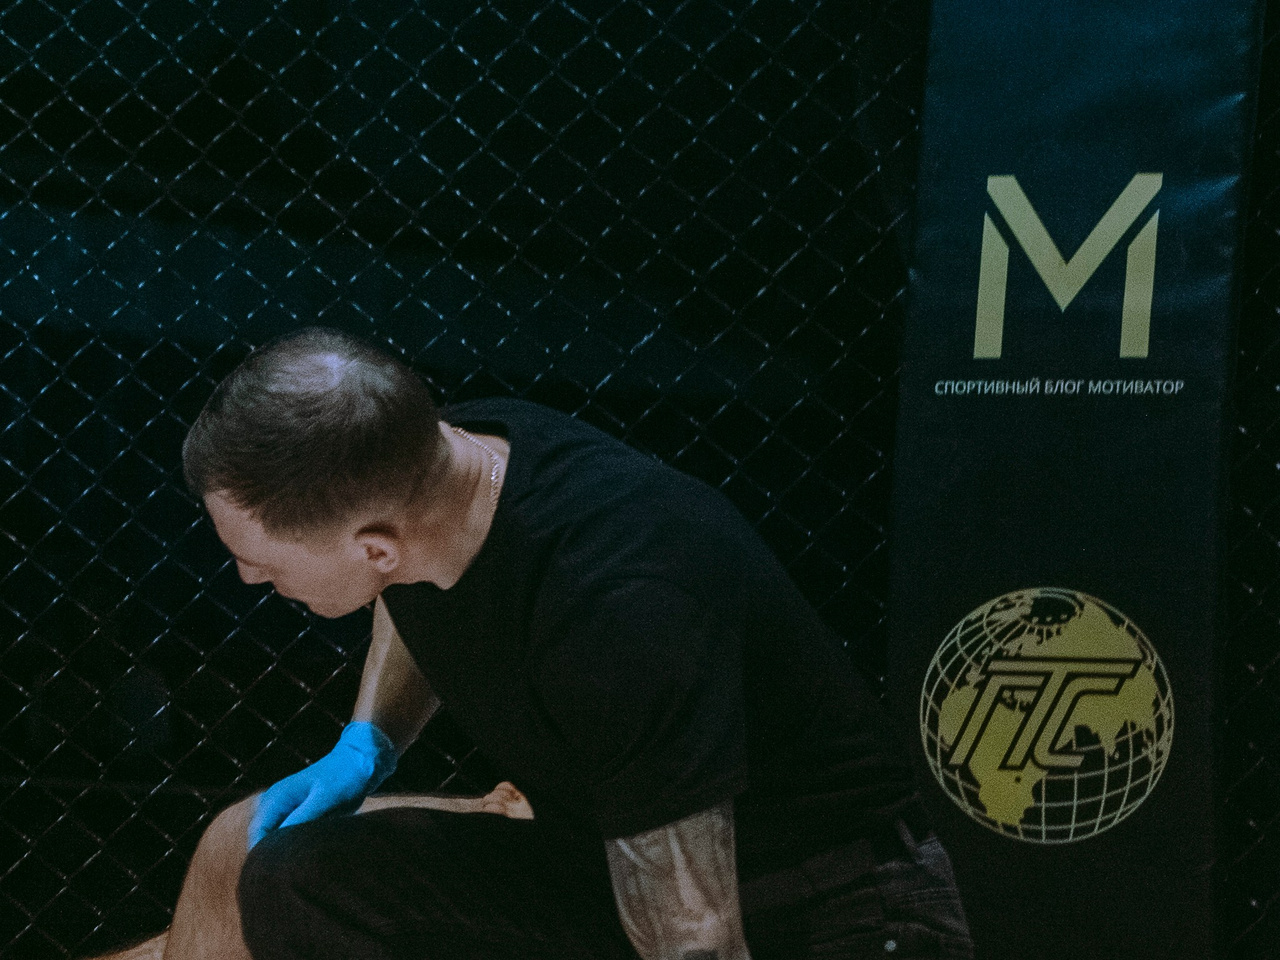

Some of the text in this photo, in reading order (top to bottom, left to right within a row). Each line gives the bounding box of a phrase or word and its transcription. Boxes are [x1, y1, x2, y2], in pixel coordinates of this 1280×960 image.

[934, 377, 1184, 396] СПОРТИВНЫЙ БЛОГ МОТИВАТОР
